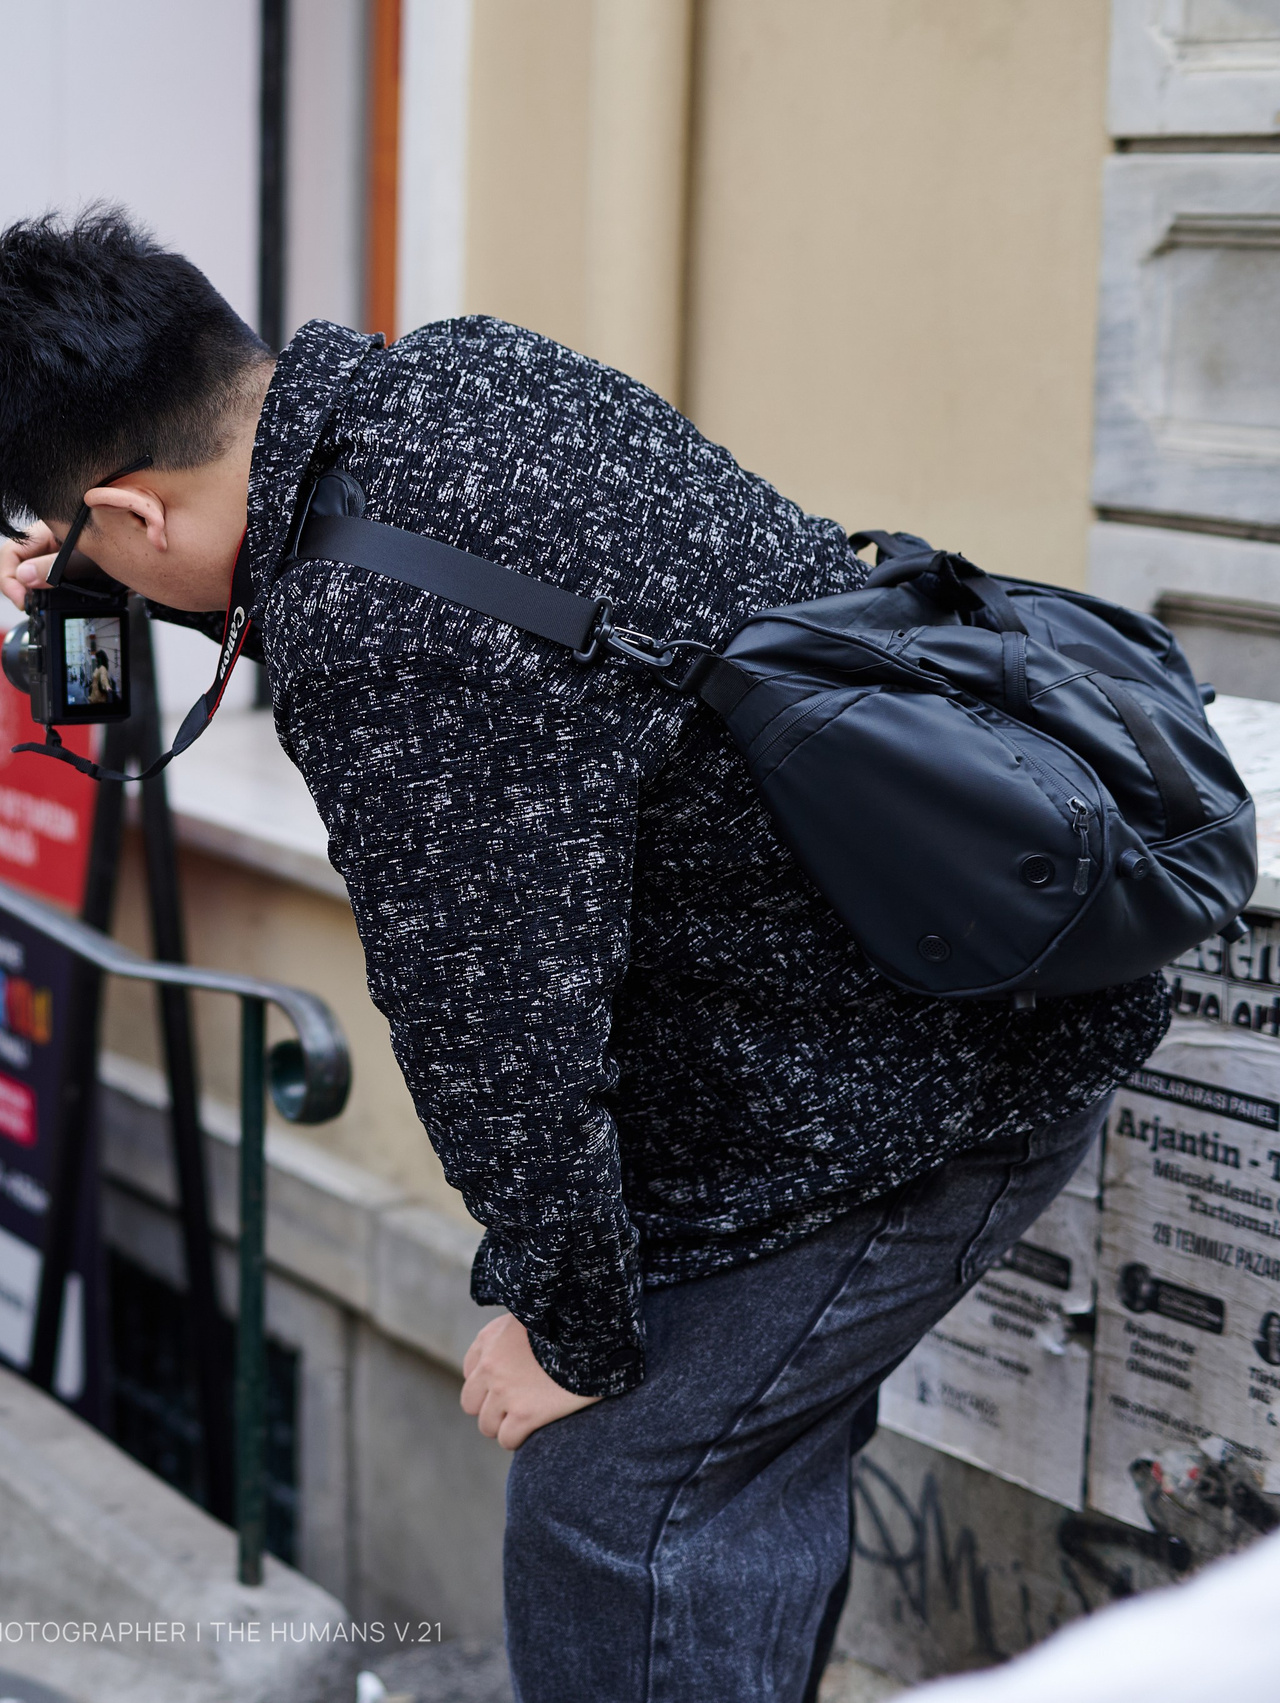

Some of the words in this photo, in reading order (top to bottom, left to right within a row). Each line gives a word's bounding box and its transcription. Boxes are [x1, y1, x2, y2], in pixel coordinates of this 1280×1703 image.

[220, 606, 245, 680] Canon
[1229, 1096, 1276, 1124] PANEL
[1116, 1106, 1240, 1169] Arjantin
[1176, 1227, 1234, 1266] TEMMUZ
